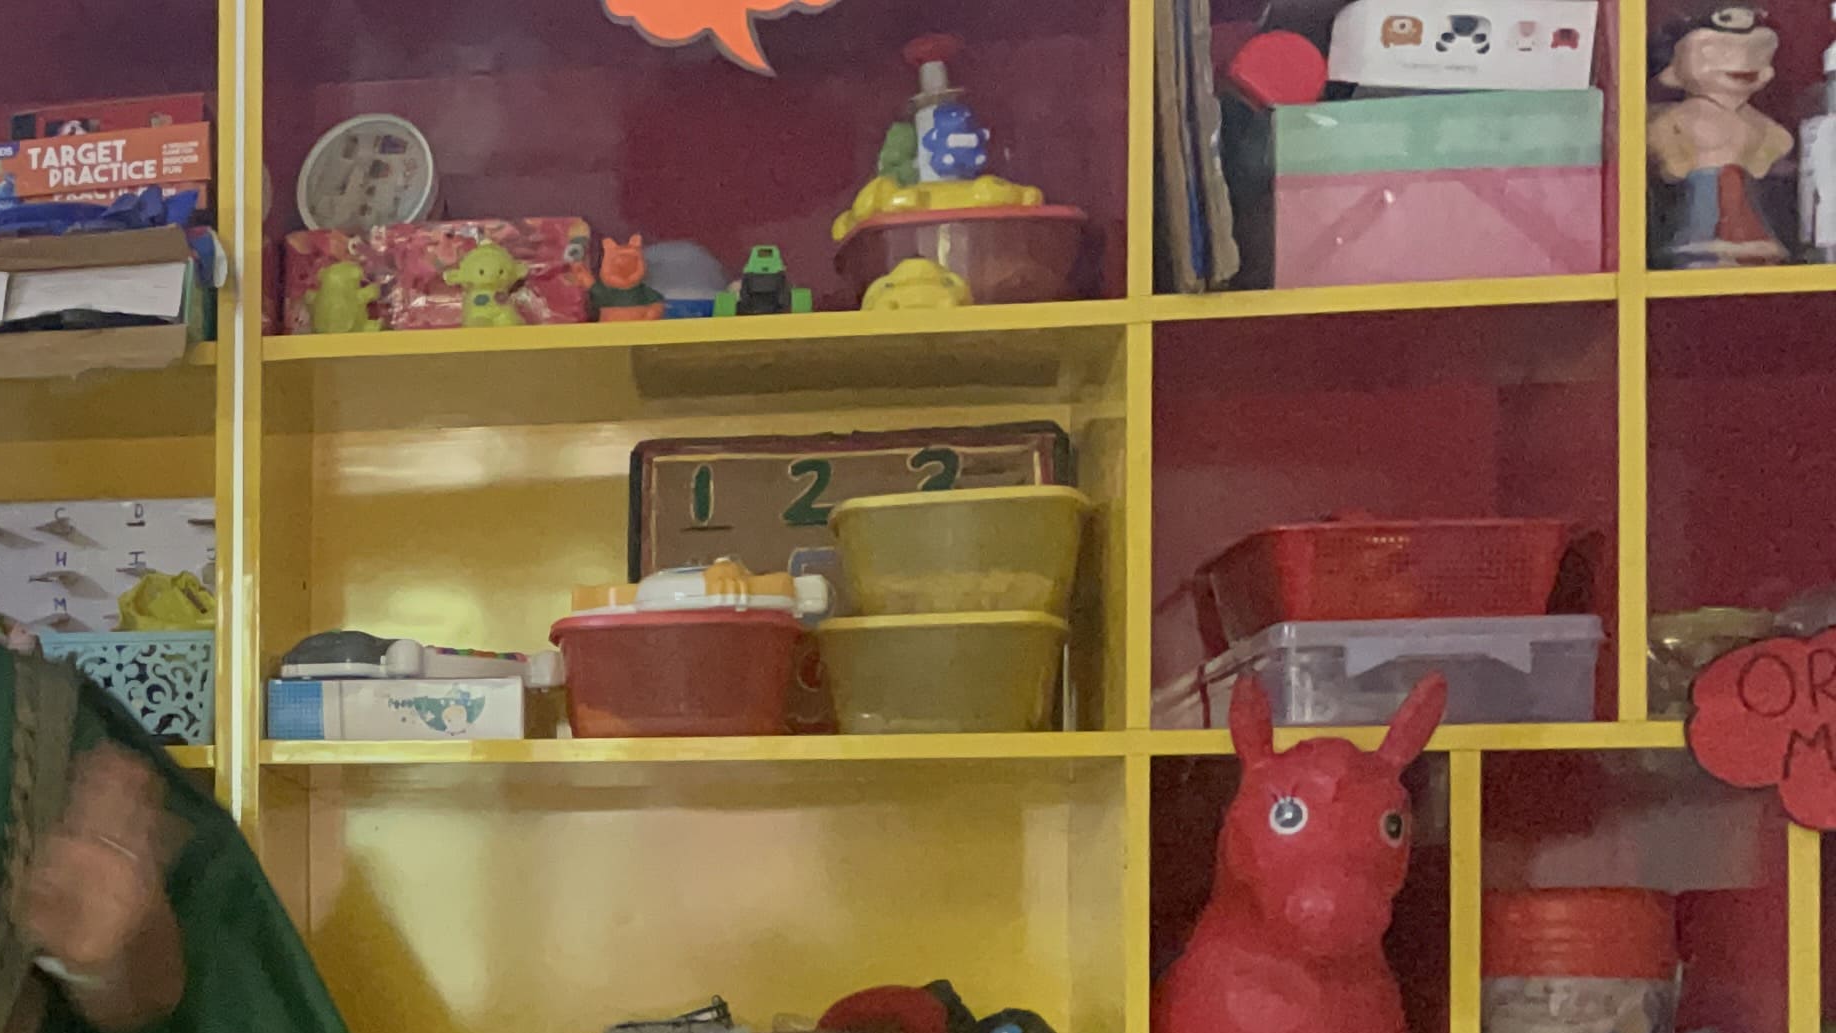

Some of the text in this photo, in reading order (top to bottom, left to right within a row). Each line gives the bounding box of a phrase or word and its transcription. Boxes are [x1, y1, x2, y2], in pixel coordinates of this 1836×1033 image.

[27, 139, 127, 170] TARGET
[48, 159, 157, 188] PRACTICE
[690, 463, 714, 527] 1
[781, 458, 833, 527] 2
[134, 503, 144, 518] D
[56, 551, 67, 566] H
[55, 598, 67, 610] M
